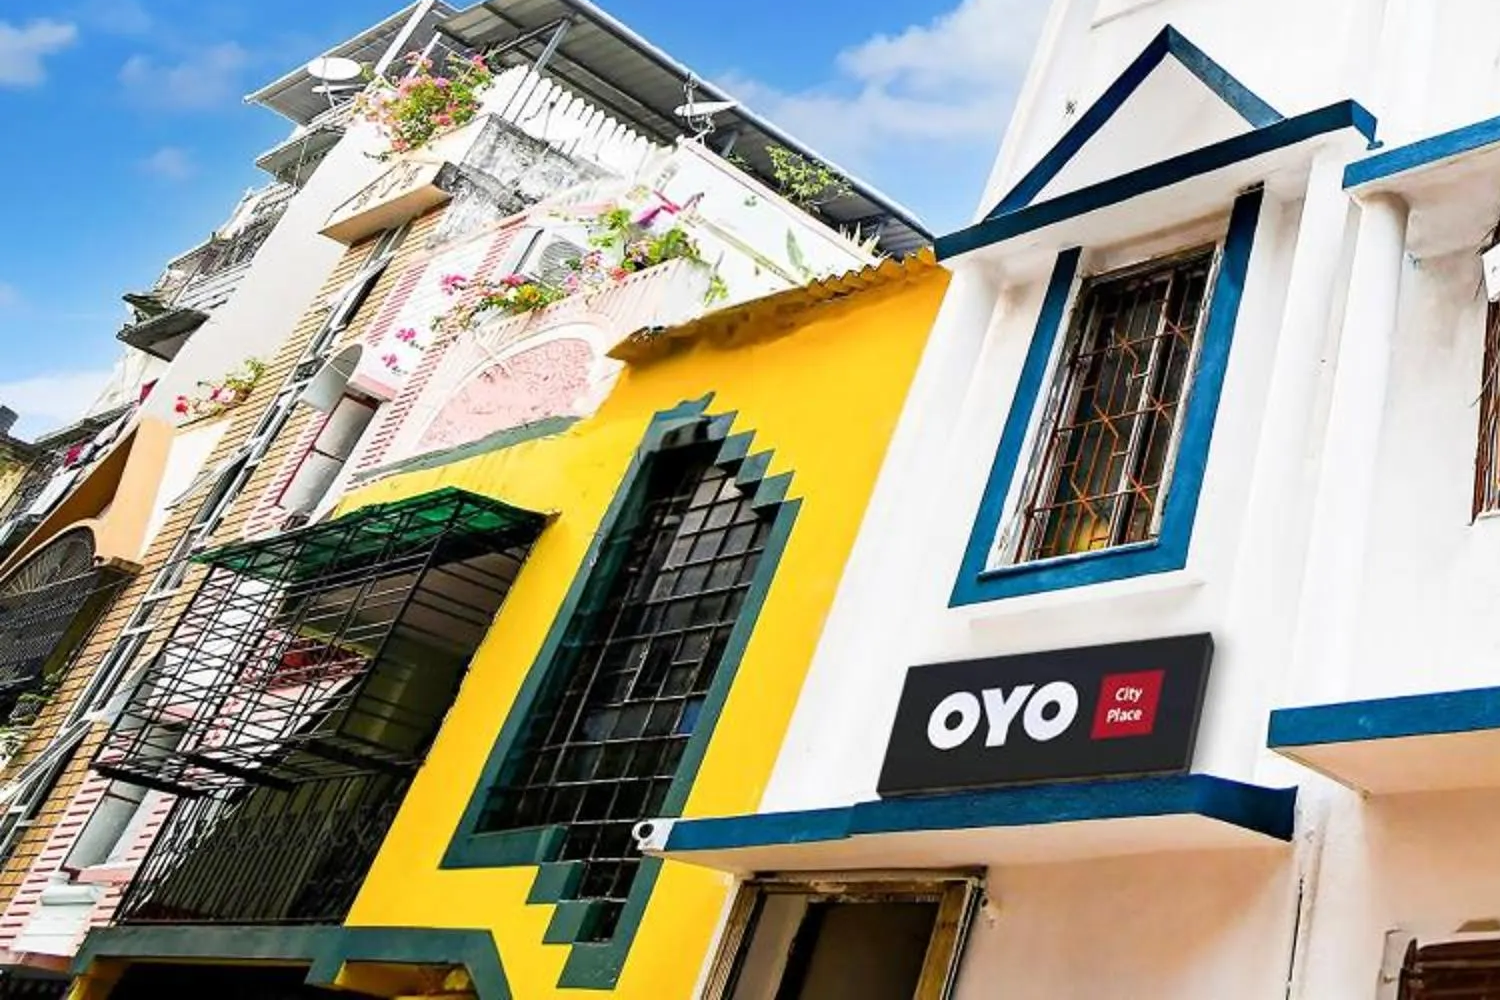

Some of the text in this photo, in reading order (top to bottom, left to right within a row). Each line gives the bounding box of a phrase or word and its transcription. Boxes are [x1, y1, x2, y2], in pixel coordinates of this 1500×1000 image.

[1115, 686, 1143, 703] City
[927, 680, 1079, 749] OYO
[1106, 707, 1143, 723] Place
